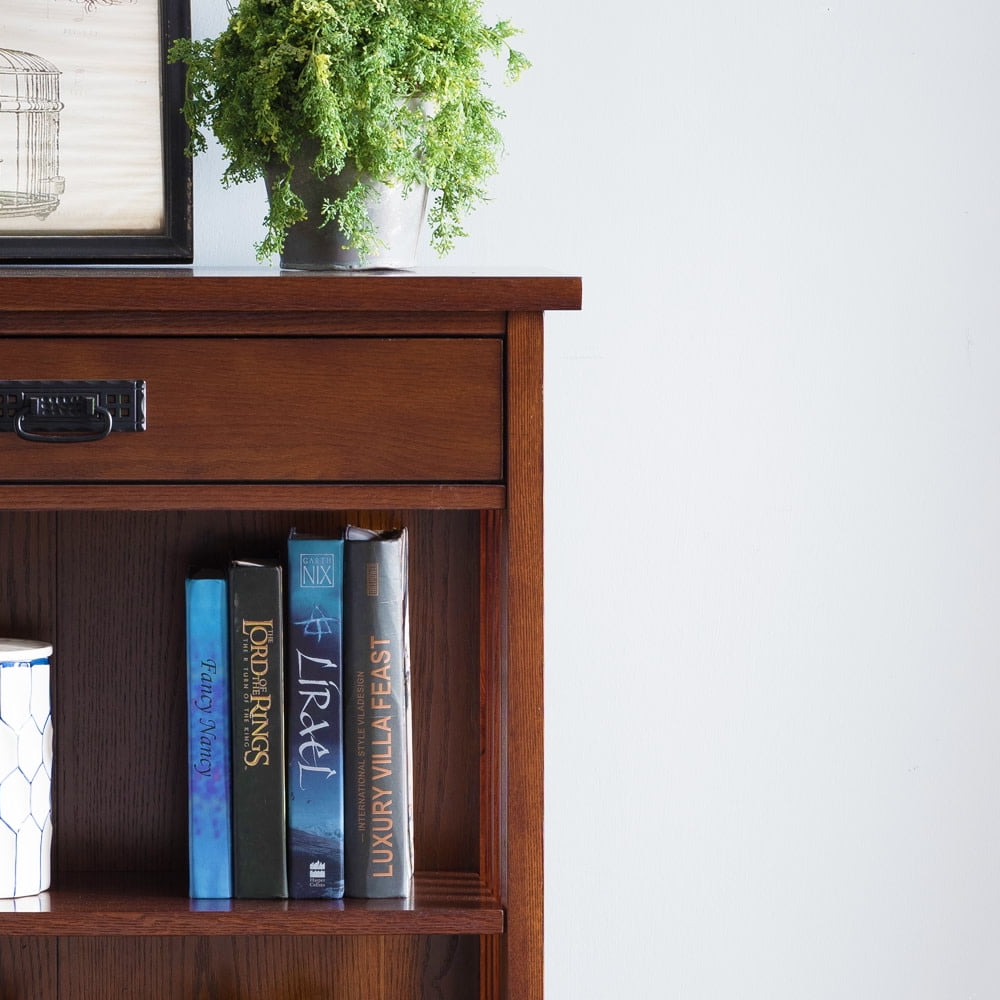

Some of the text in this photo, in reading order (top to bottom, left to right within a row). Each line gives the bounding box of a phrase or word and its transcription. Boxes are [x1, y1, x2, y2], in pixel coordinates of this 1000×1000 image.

[303, 565, 332, 585] NIX
[194, 659, 217, 777] Fancy Nancy
[242, 618, 274, 767] LORD OF THE RINGS
[243, 693, 249, 703] OF
[357, 728, 366, 757] STYLE
[371, 635, 394, 878] LUXURY VILLA FEAST
[357, 760, 366, 831] INTERNATIONAL
